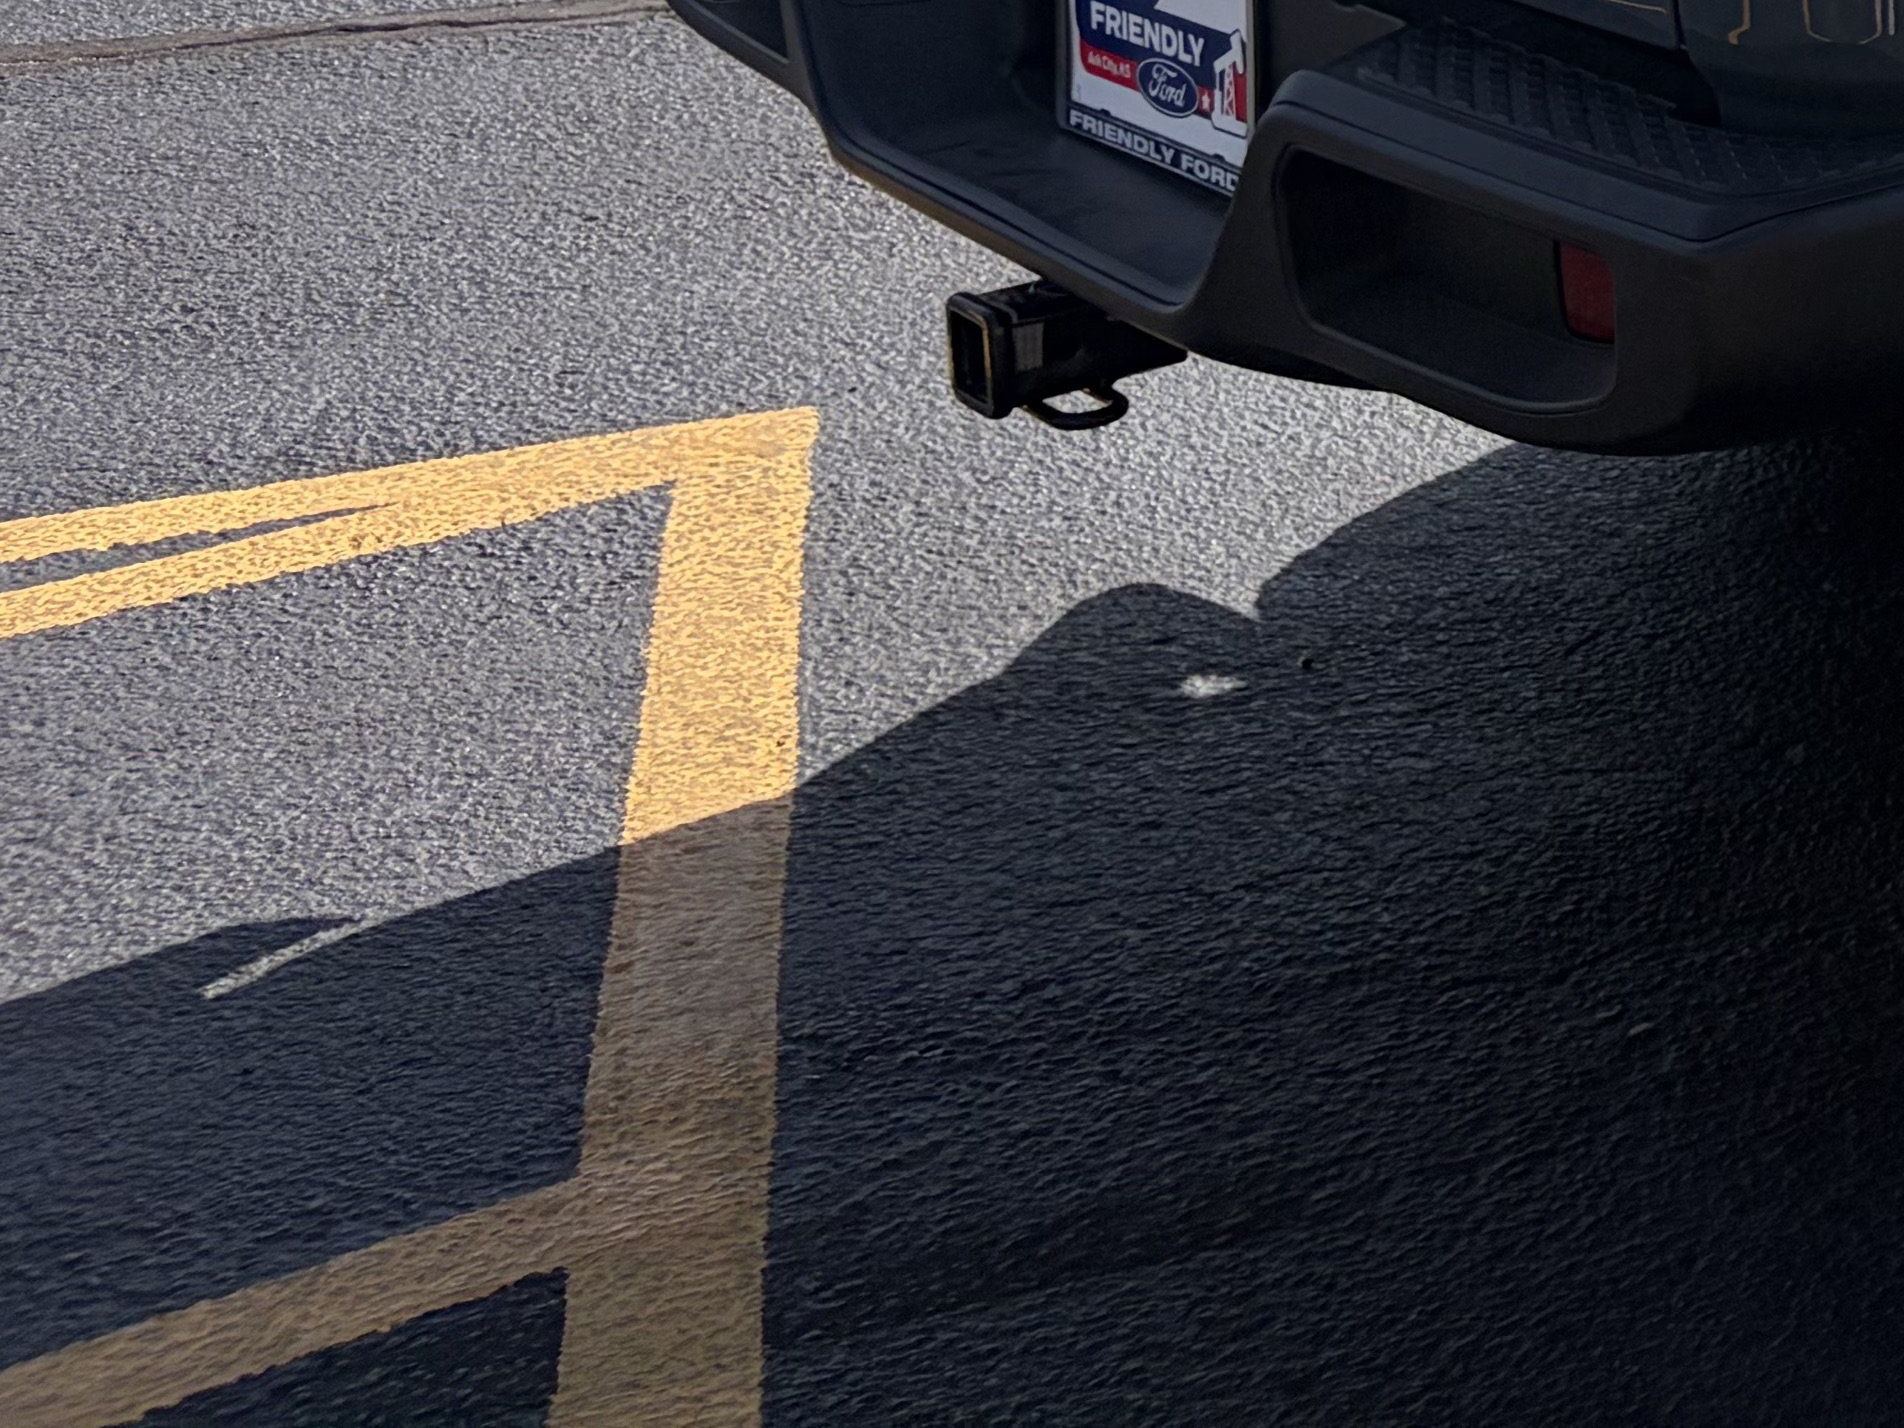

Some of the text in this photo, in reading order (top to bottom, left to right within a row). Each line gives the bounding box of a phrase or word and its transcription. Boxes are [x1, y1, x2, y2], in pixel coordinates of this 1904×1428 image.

[1090, 0, 1205, 67] FRIENDLY
[1147, 62, 1187, 108] Ford
[1069, 109, 1240, 192] FRIENDLY FORD
